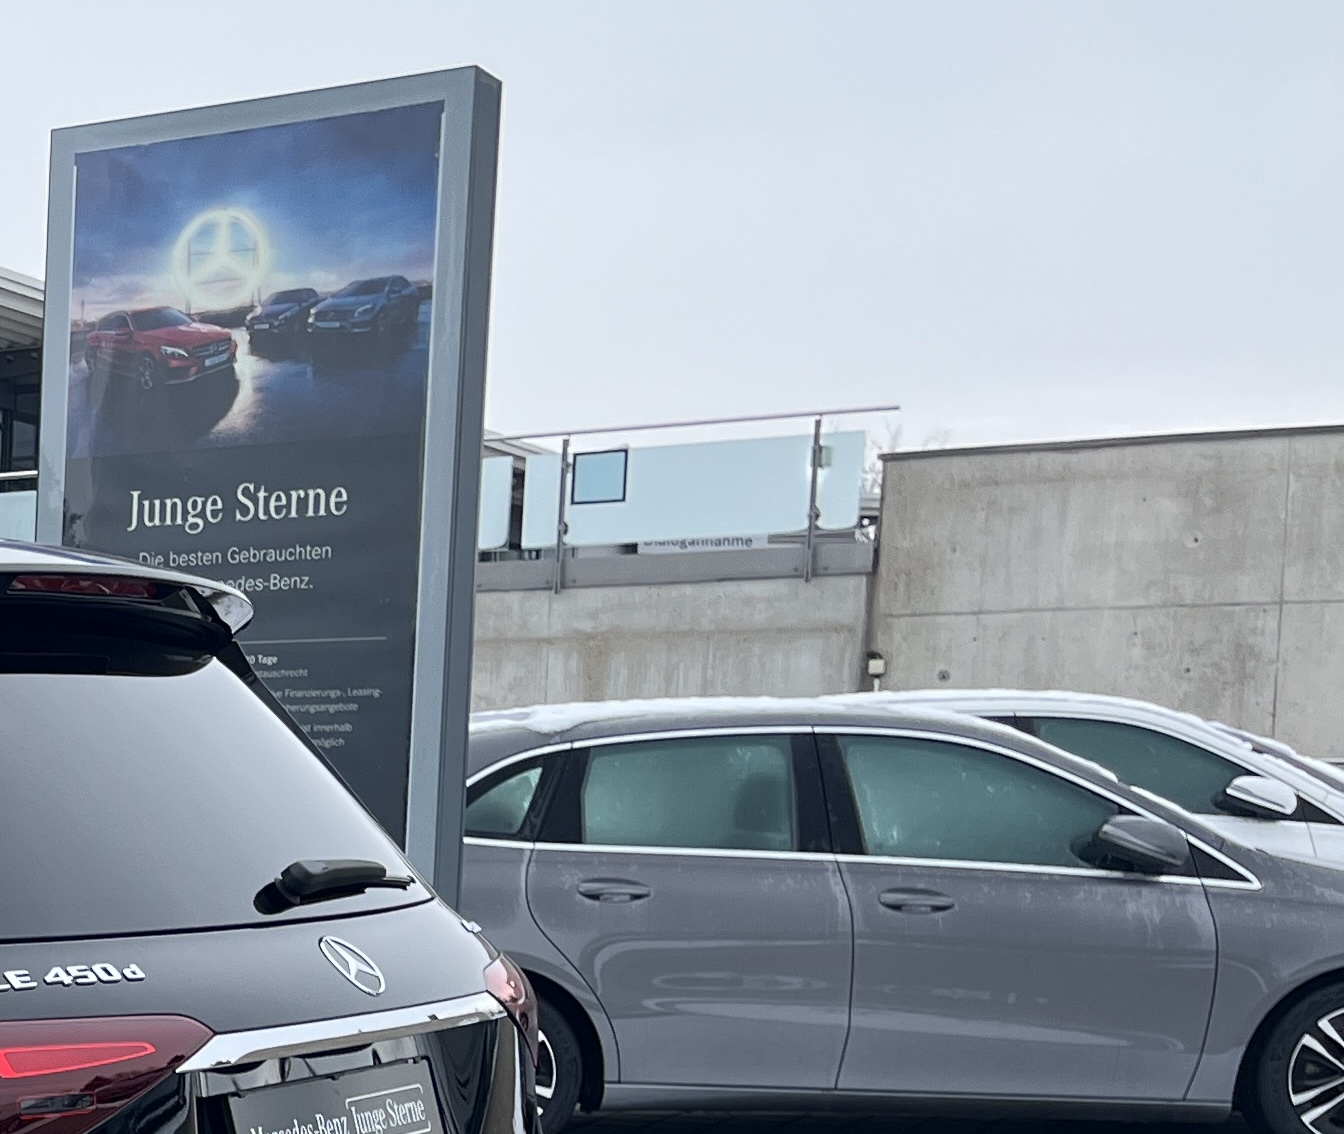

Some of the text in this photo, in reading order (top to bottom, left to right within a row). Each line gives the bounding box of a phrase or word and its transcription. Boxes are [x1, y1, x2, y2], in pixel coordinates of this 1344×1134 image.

[127, 482, 348, 534] Junge Sterne
[138, 544, 332, 567] Die besten Gebrauchten
[257, 654, 278, 666] Tage
[385, 1098, 426, 1128] Sterne
